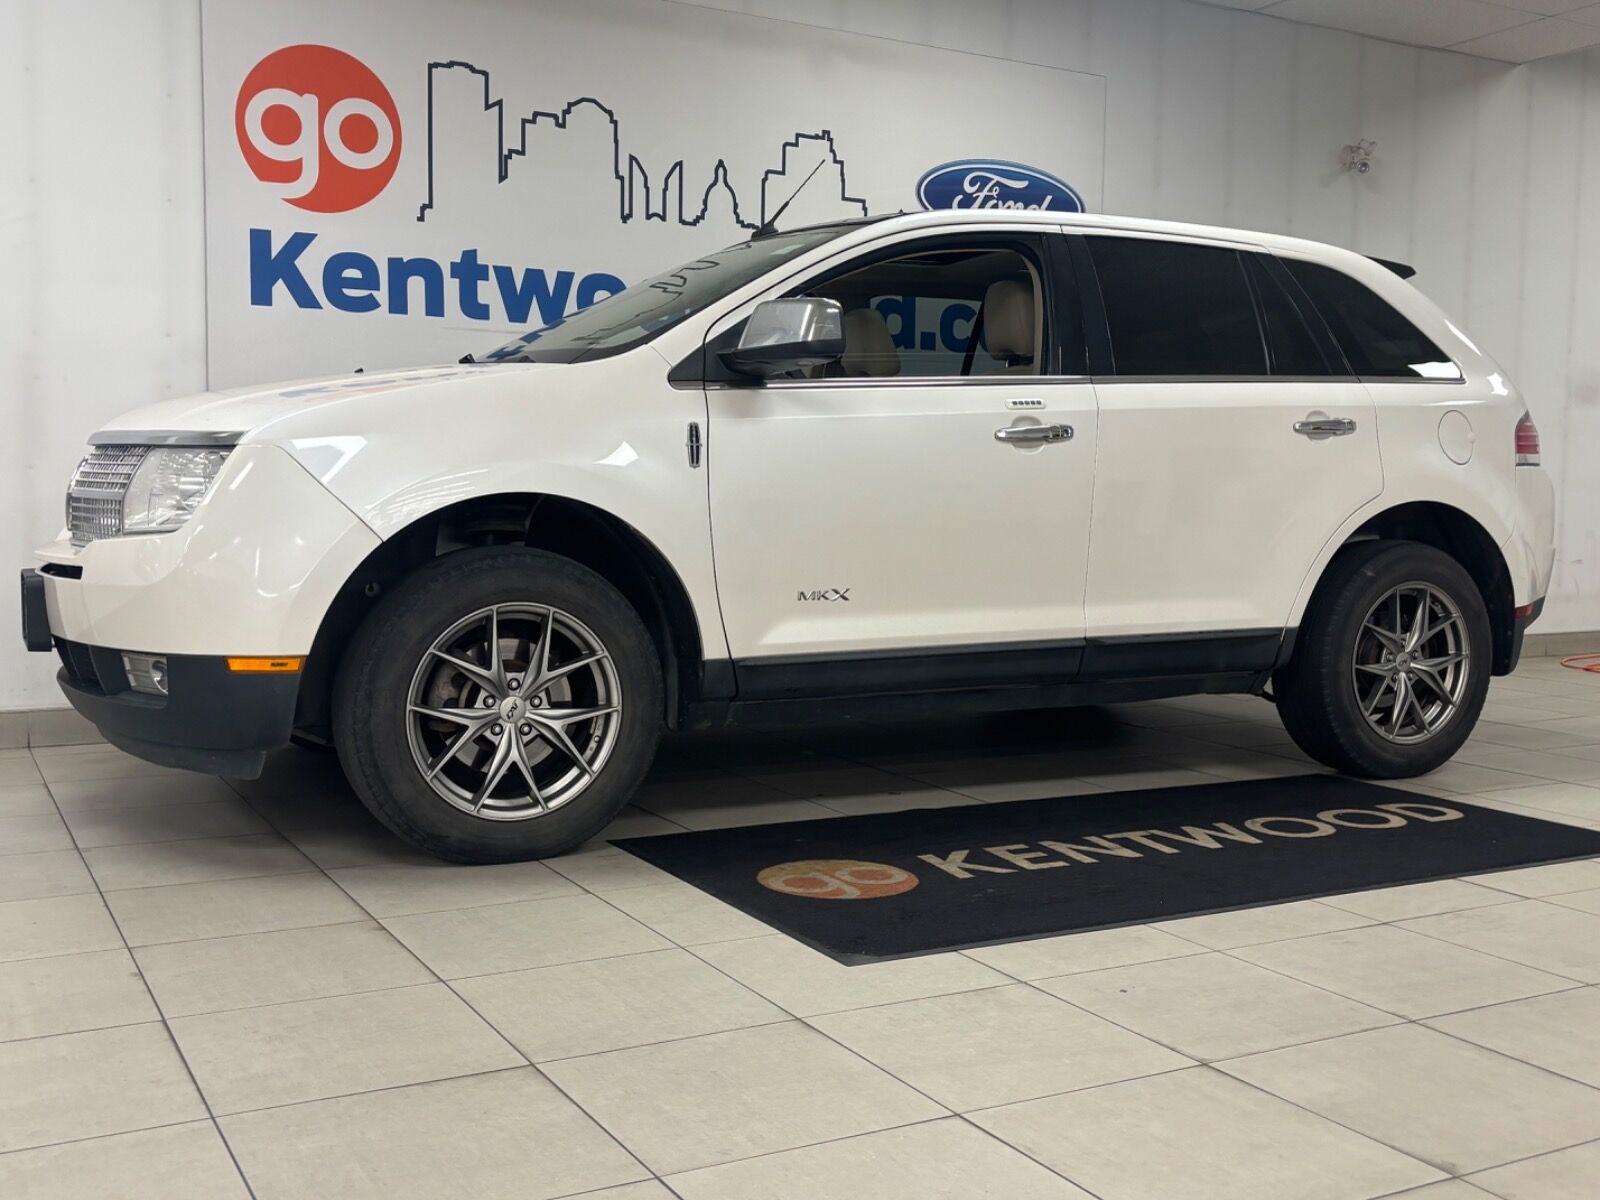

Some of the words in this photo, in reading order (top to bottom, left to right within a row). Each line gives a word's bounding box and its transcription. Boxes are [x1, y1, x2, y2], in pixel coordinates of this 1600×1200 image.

[244, 88, 393, 199] go
[797, 588, 850, 601] MKX
[917, 803, 1464, 879] KENTWOOD
[768, 866, 909, 899] go
